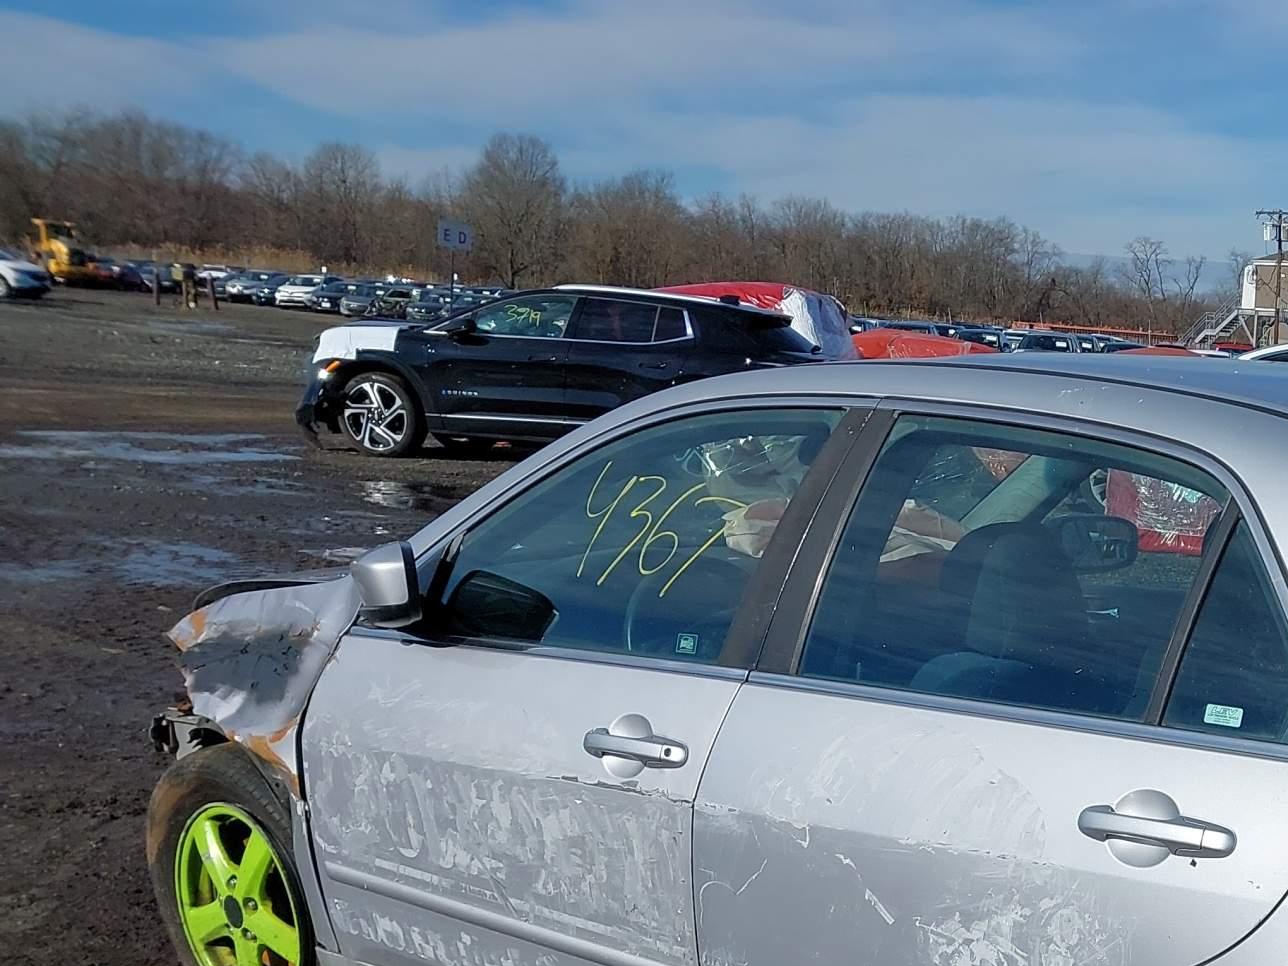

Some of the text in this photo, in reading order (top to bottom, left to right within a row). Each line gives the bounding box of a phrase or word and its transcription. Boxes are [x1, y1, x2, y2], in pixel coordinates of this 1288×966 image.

[444, 229, 467, 244] E D
[576, 460, 748, 597] 4367
